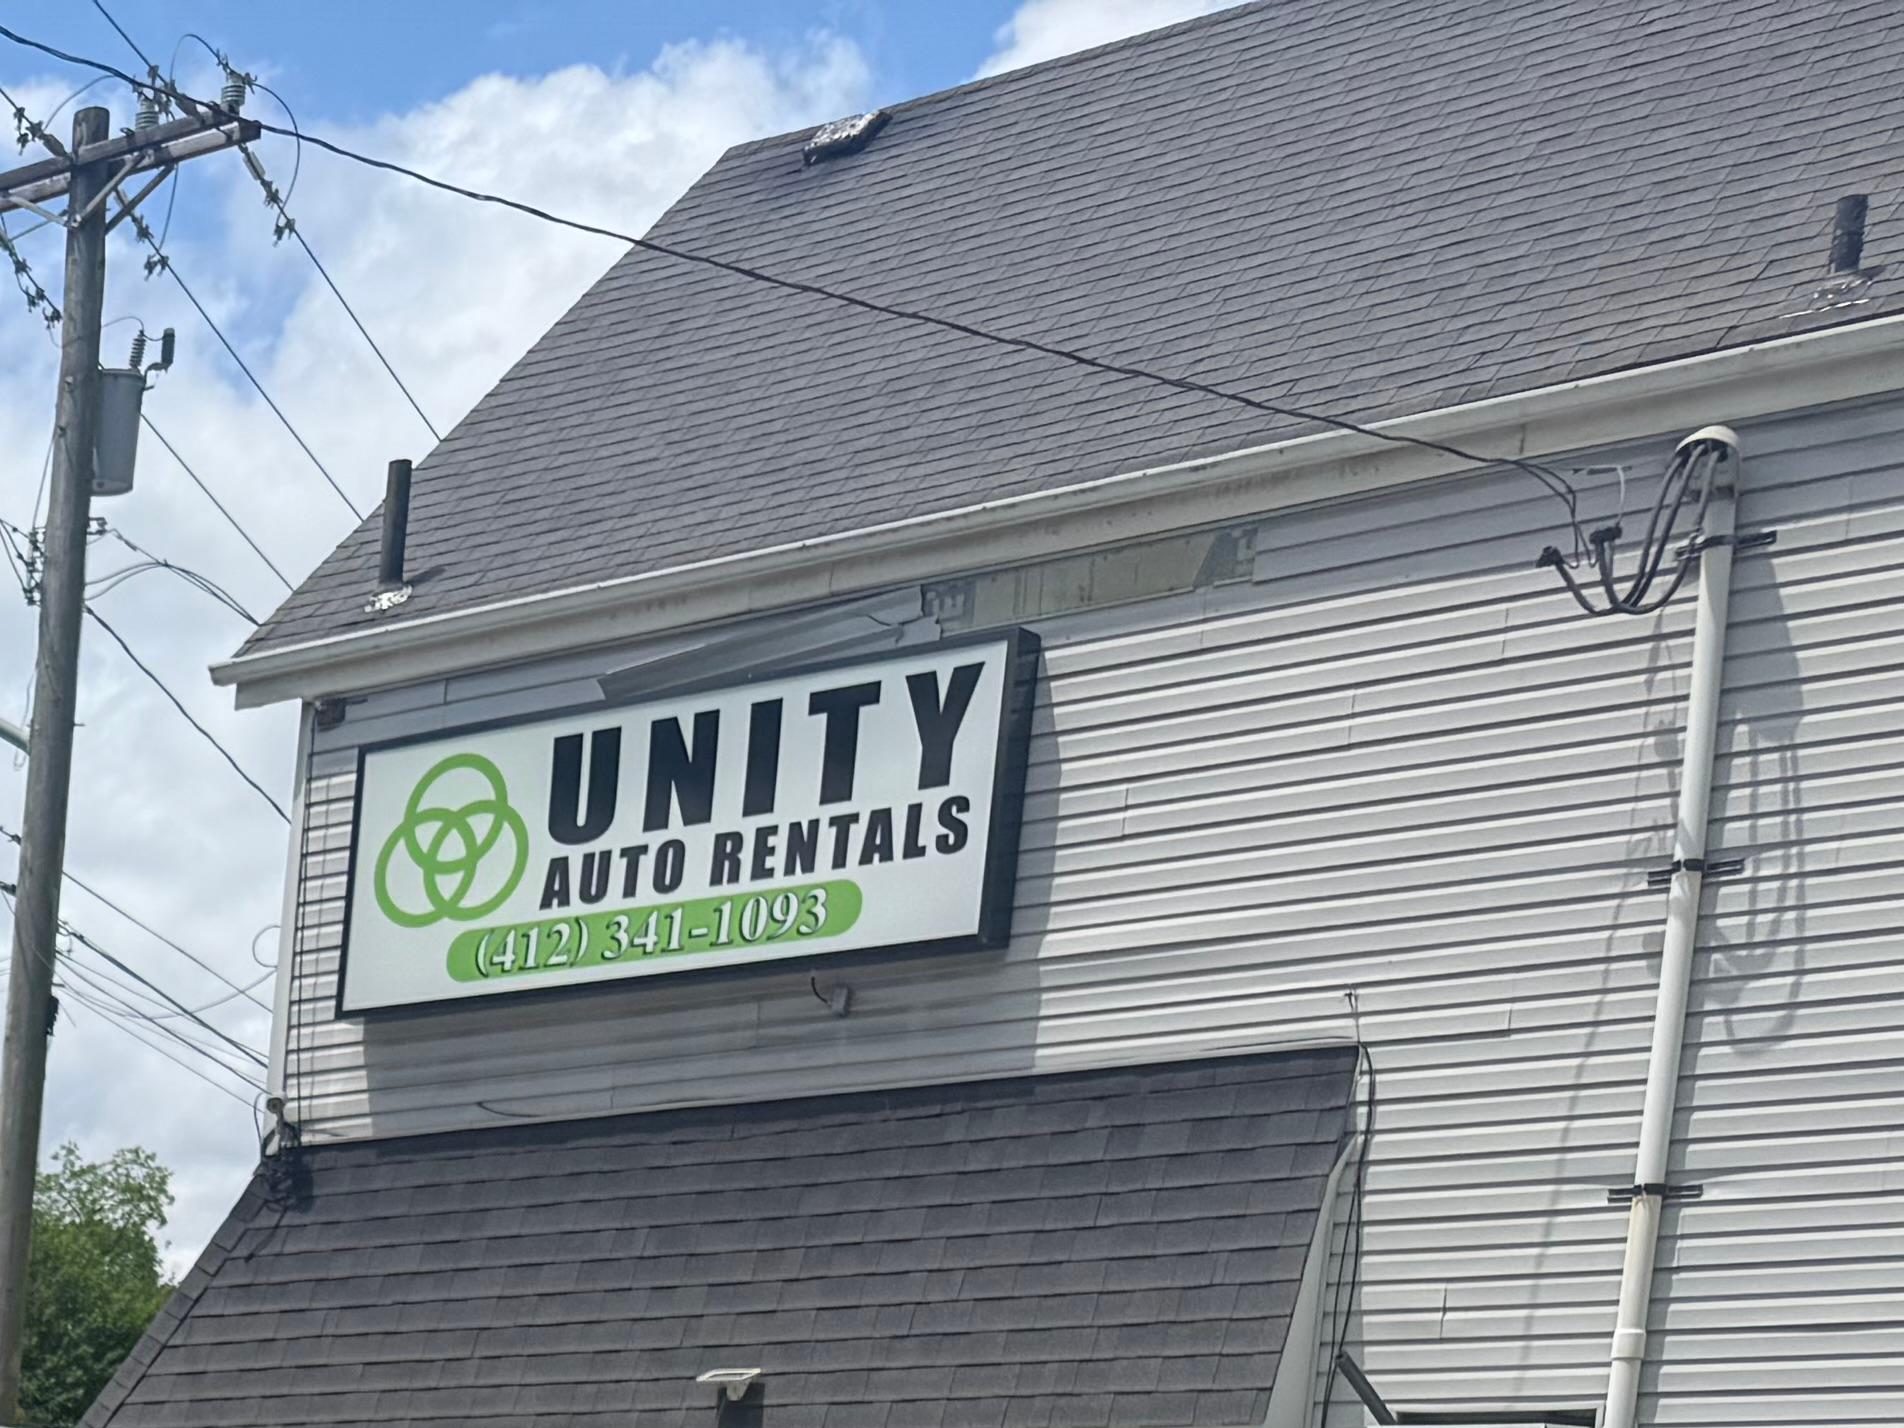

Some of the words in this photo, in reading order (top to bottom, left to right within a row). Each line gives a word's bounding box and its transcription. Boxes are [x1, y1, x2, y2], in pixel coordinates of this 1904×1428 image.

[546, 660, 985, 846] UNITY
[539, 839, 687, 911] AUTO
[709, 795, 971, 887] RENTALS
[473, 919, 589, 978] (412)
[601, 889, 829, 962] 341-1093
